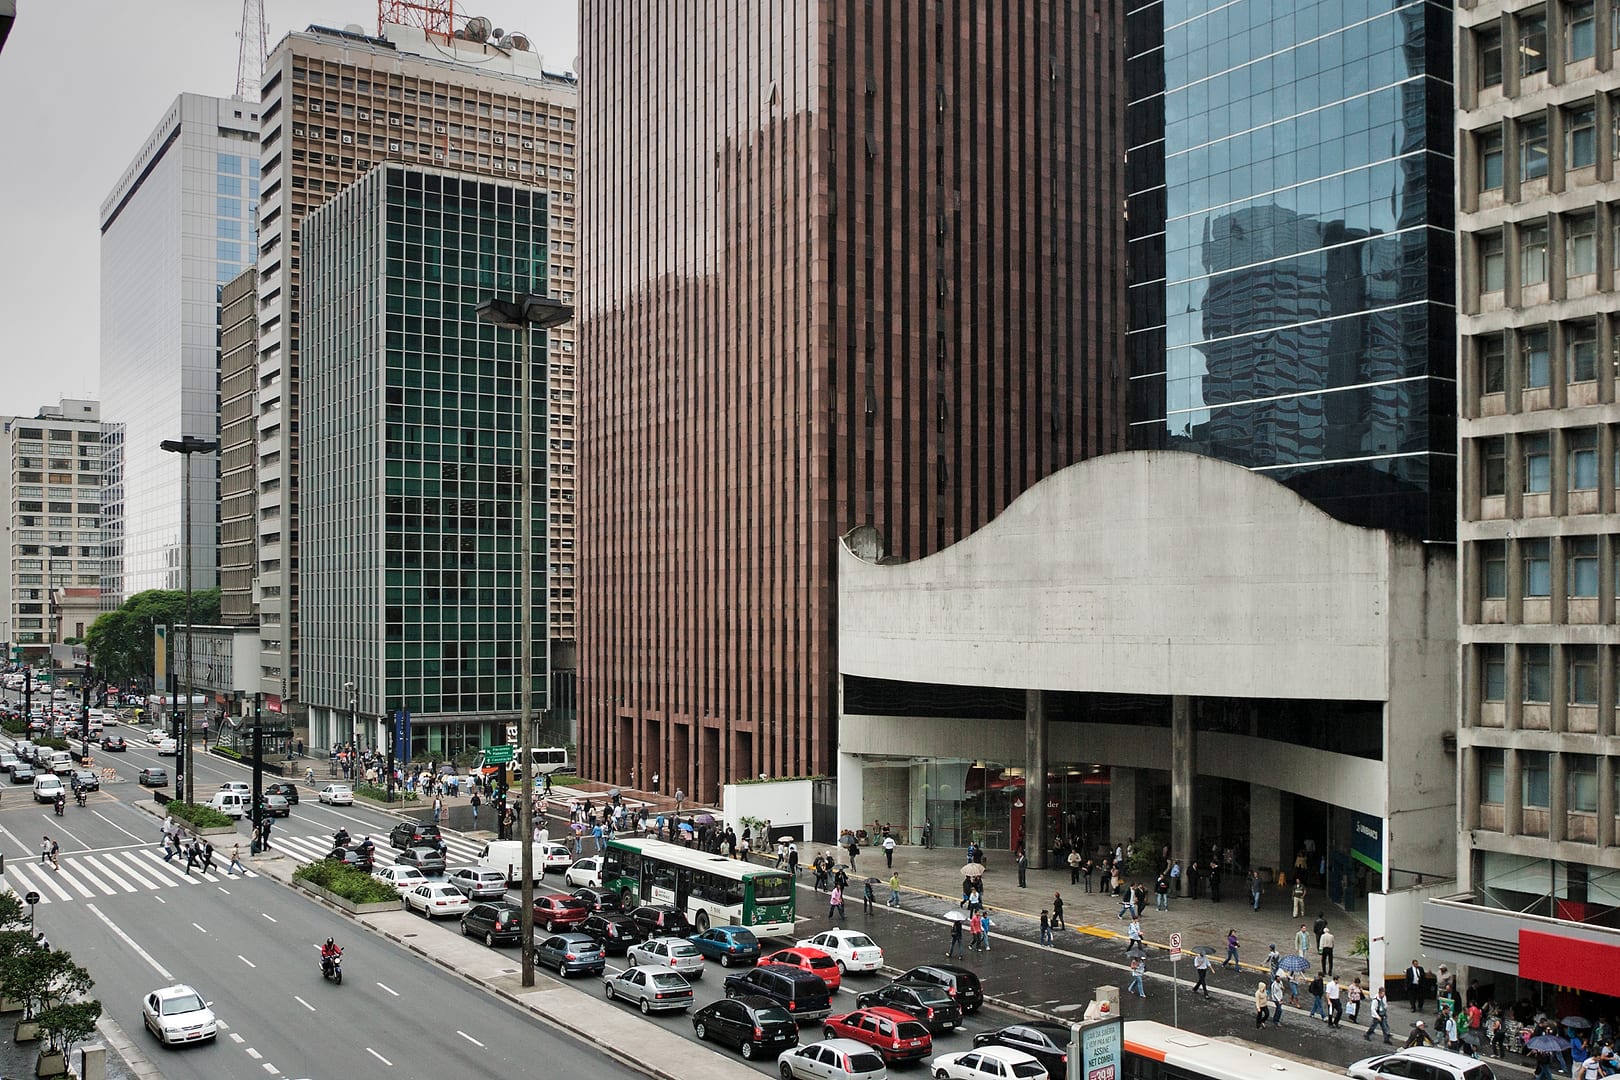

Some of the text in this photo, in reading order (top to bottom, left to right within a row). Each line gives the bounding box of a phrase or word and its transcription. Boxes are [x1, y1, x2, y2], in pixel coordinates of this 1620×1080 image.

[1094, 1045, 1109, 1056] ASSINE
[1089, 1054, 1113, 1067] NET COMBO
